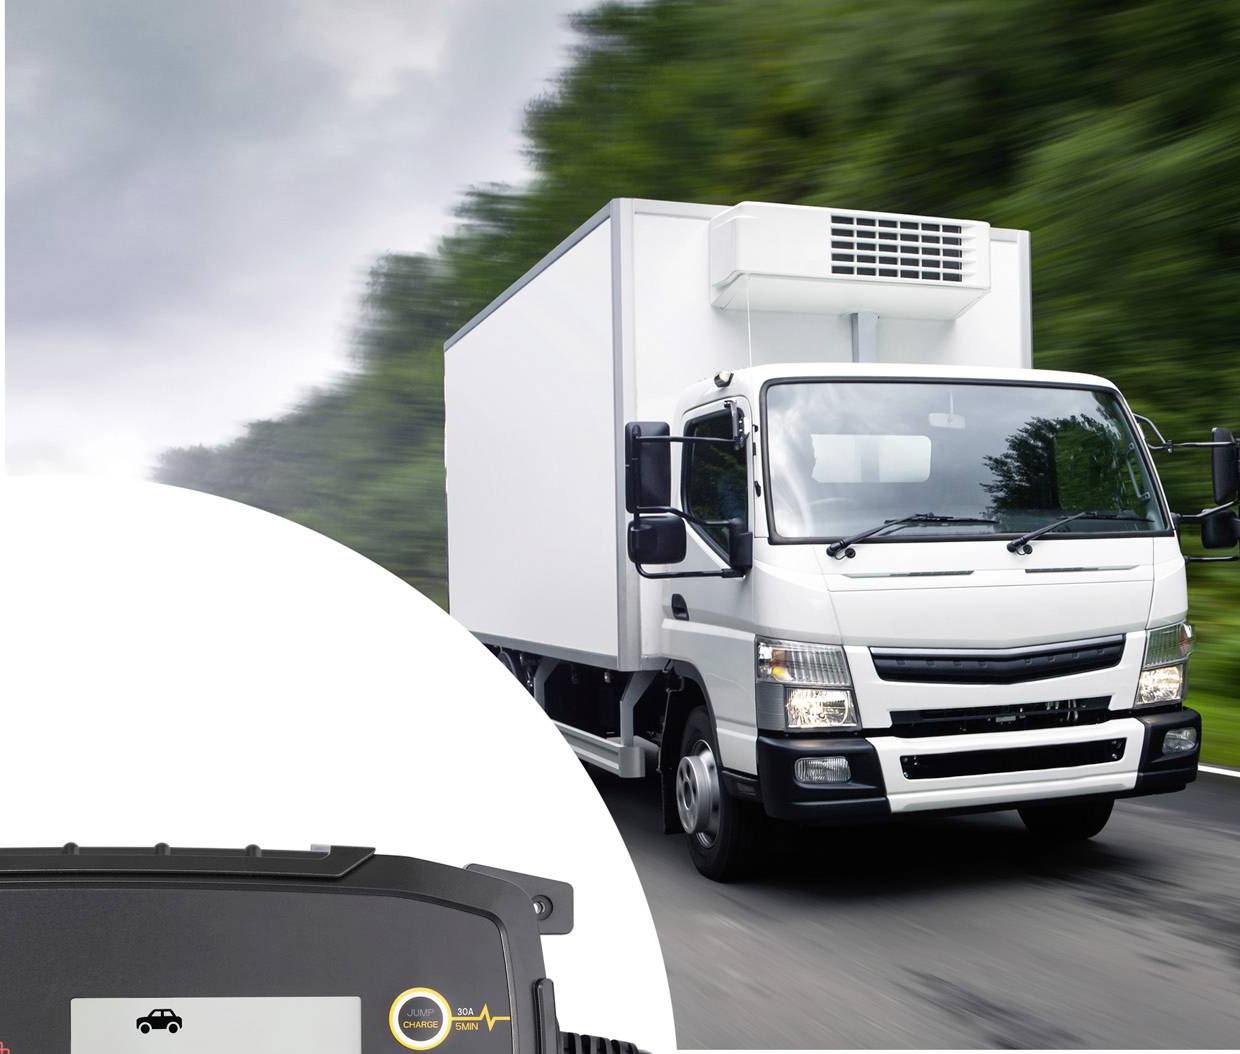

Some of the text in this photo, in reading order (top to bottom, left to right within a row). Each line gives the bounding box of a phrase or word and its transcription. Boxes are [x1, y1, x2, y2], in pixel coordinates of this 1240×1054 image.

[406, 1009, 435, 1018] JUMP
[457, 1007, 474, 1016] 30A
[402, 1020, 439, 1029] CHARGE
[455, 1023, 479, 1031] 5MIN
